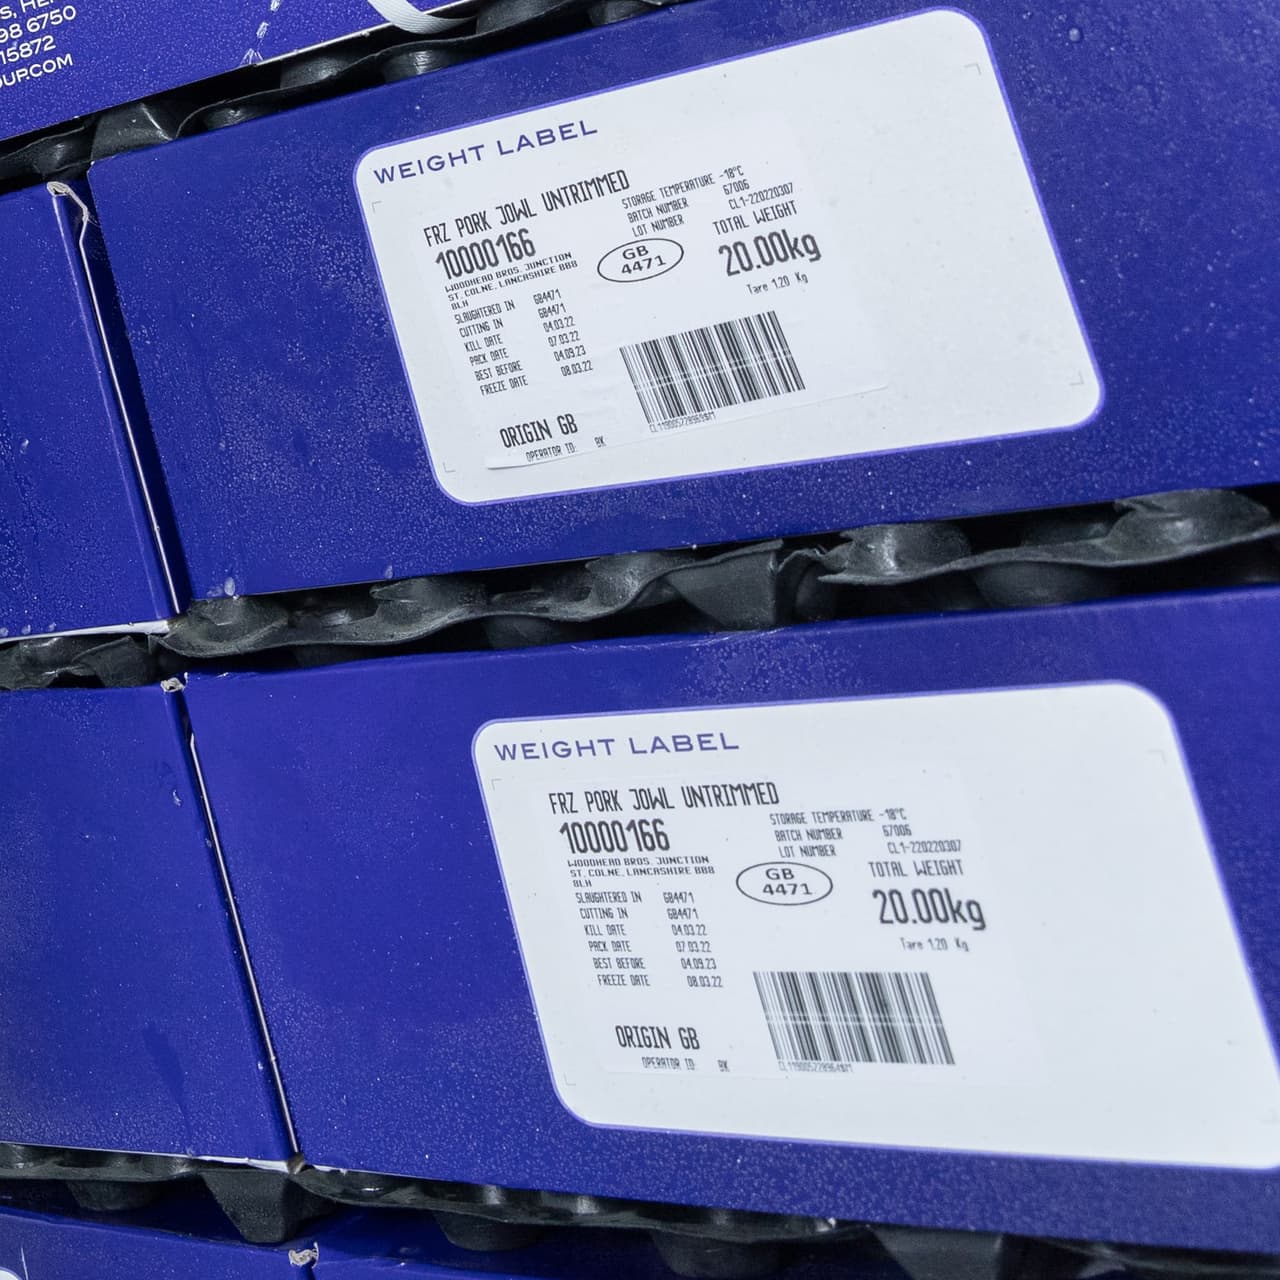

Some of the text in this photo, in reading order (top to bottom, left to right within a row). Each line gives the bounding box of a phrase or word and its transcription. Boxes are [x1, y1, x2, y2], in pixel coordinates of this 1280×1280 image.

[26, 5, 76, 32] 6750
[373, 120, 597, 184] WEIGHT LABEL
[423, 169, 629, 247] FRZ PORK JOWL UNTRIMMED
[626, 207, 653, 223] BATCH
[655, 197, 688, 215] NUMBER
[631, 223, 647, 237] LOT
[650, 213, 684, 232] NUMBER
[712, 199, 797, 235] TOTAL WEIGHT
[435, 227, 536, 280] 10000166
[621, 255, 666, 274] 4471
[622, 245, 648, 260] GB
[718, 228, 821, 276] 20.00kg
[499, 413, 578, 448] ORIGIN GB
[493, 732, 739, 760] WEIGHT LABEL
[548, 781, 779, 814] FRZ PORK JOWL UNTRIMMED
[559, 818, 670, 854] 10000166
[871, 887, 986, 931] 20.00kg
